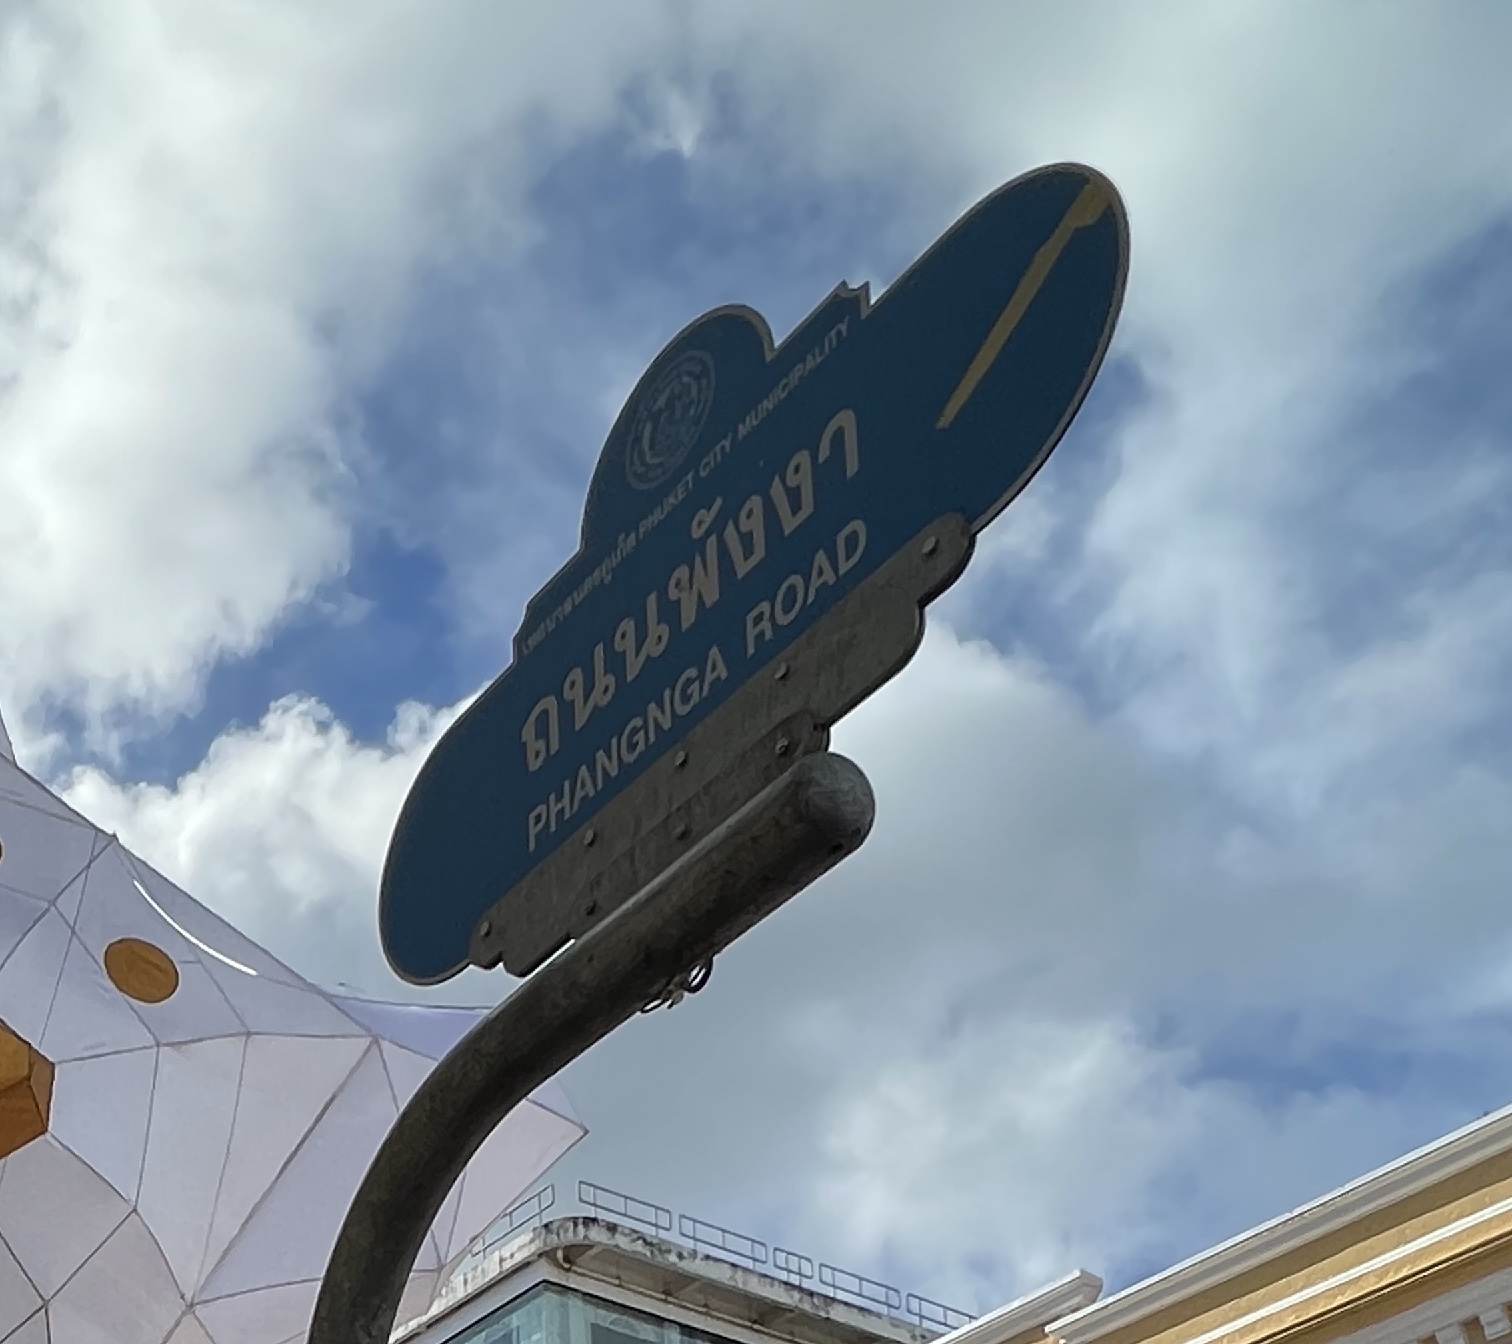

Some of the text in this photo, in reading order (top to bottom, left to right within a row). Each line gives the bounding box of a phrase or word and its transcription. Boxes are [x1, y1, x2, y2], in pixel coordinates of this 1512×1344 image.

[521, 406, 860, 772] ถนนพังงา
[638, 473, 694, 540] PHUKET
[698, 431, 733, 479] CITY
[737, 315, 851, 440] MUNICIPALITY
[527, 518, 869, 852] PHANGNGA ROAD
